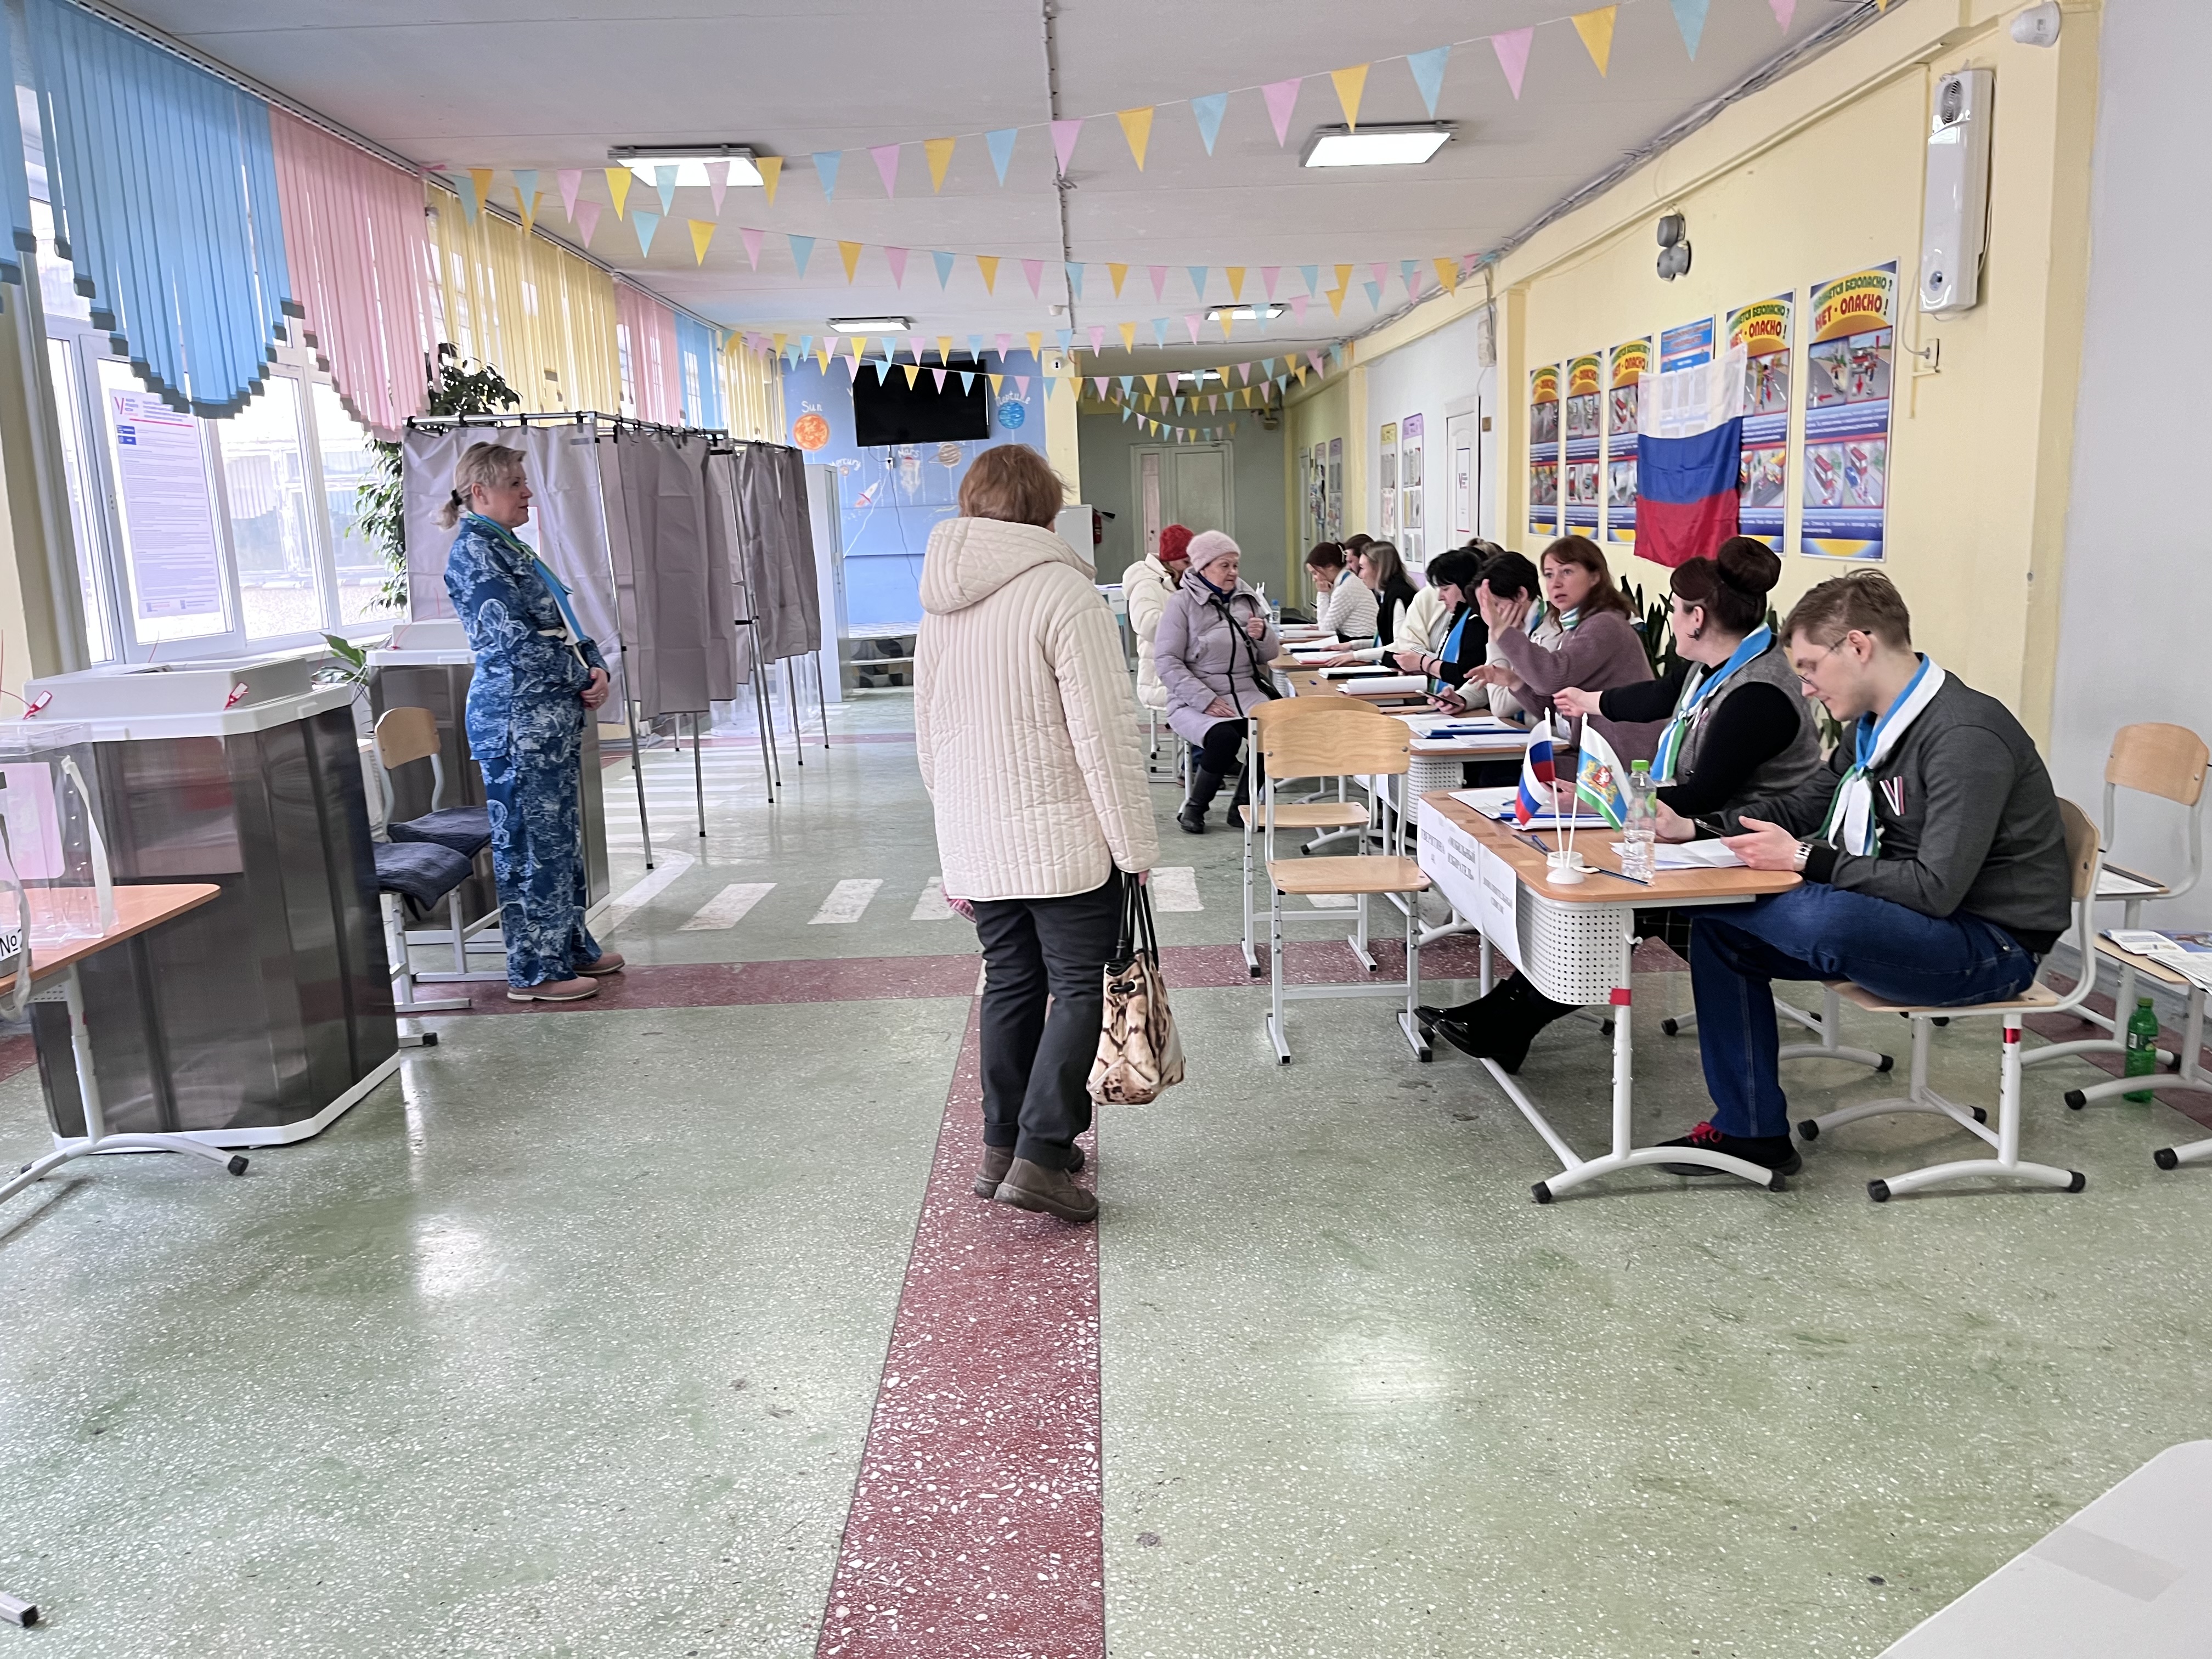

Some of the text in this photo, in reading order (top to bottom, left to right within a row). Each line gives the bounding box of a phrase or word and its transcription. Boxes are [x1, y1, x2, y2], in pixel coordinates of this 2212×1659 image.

[1840, 294, 1882, 315] ОПАСНО
[1749, 320, 1782, 338] ОПАСНО
[801, 400, 822, 413] Sun
